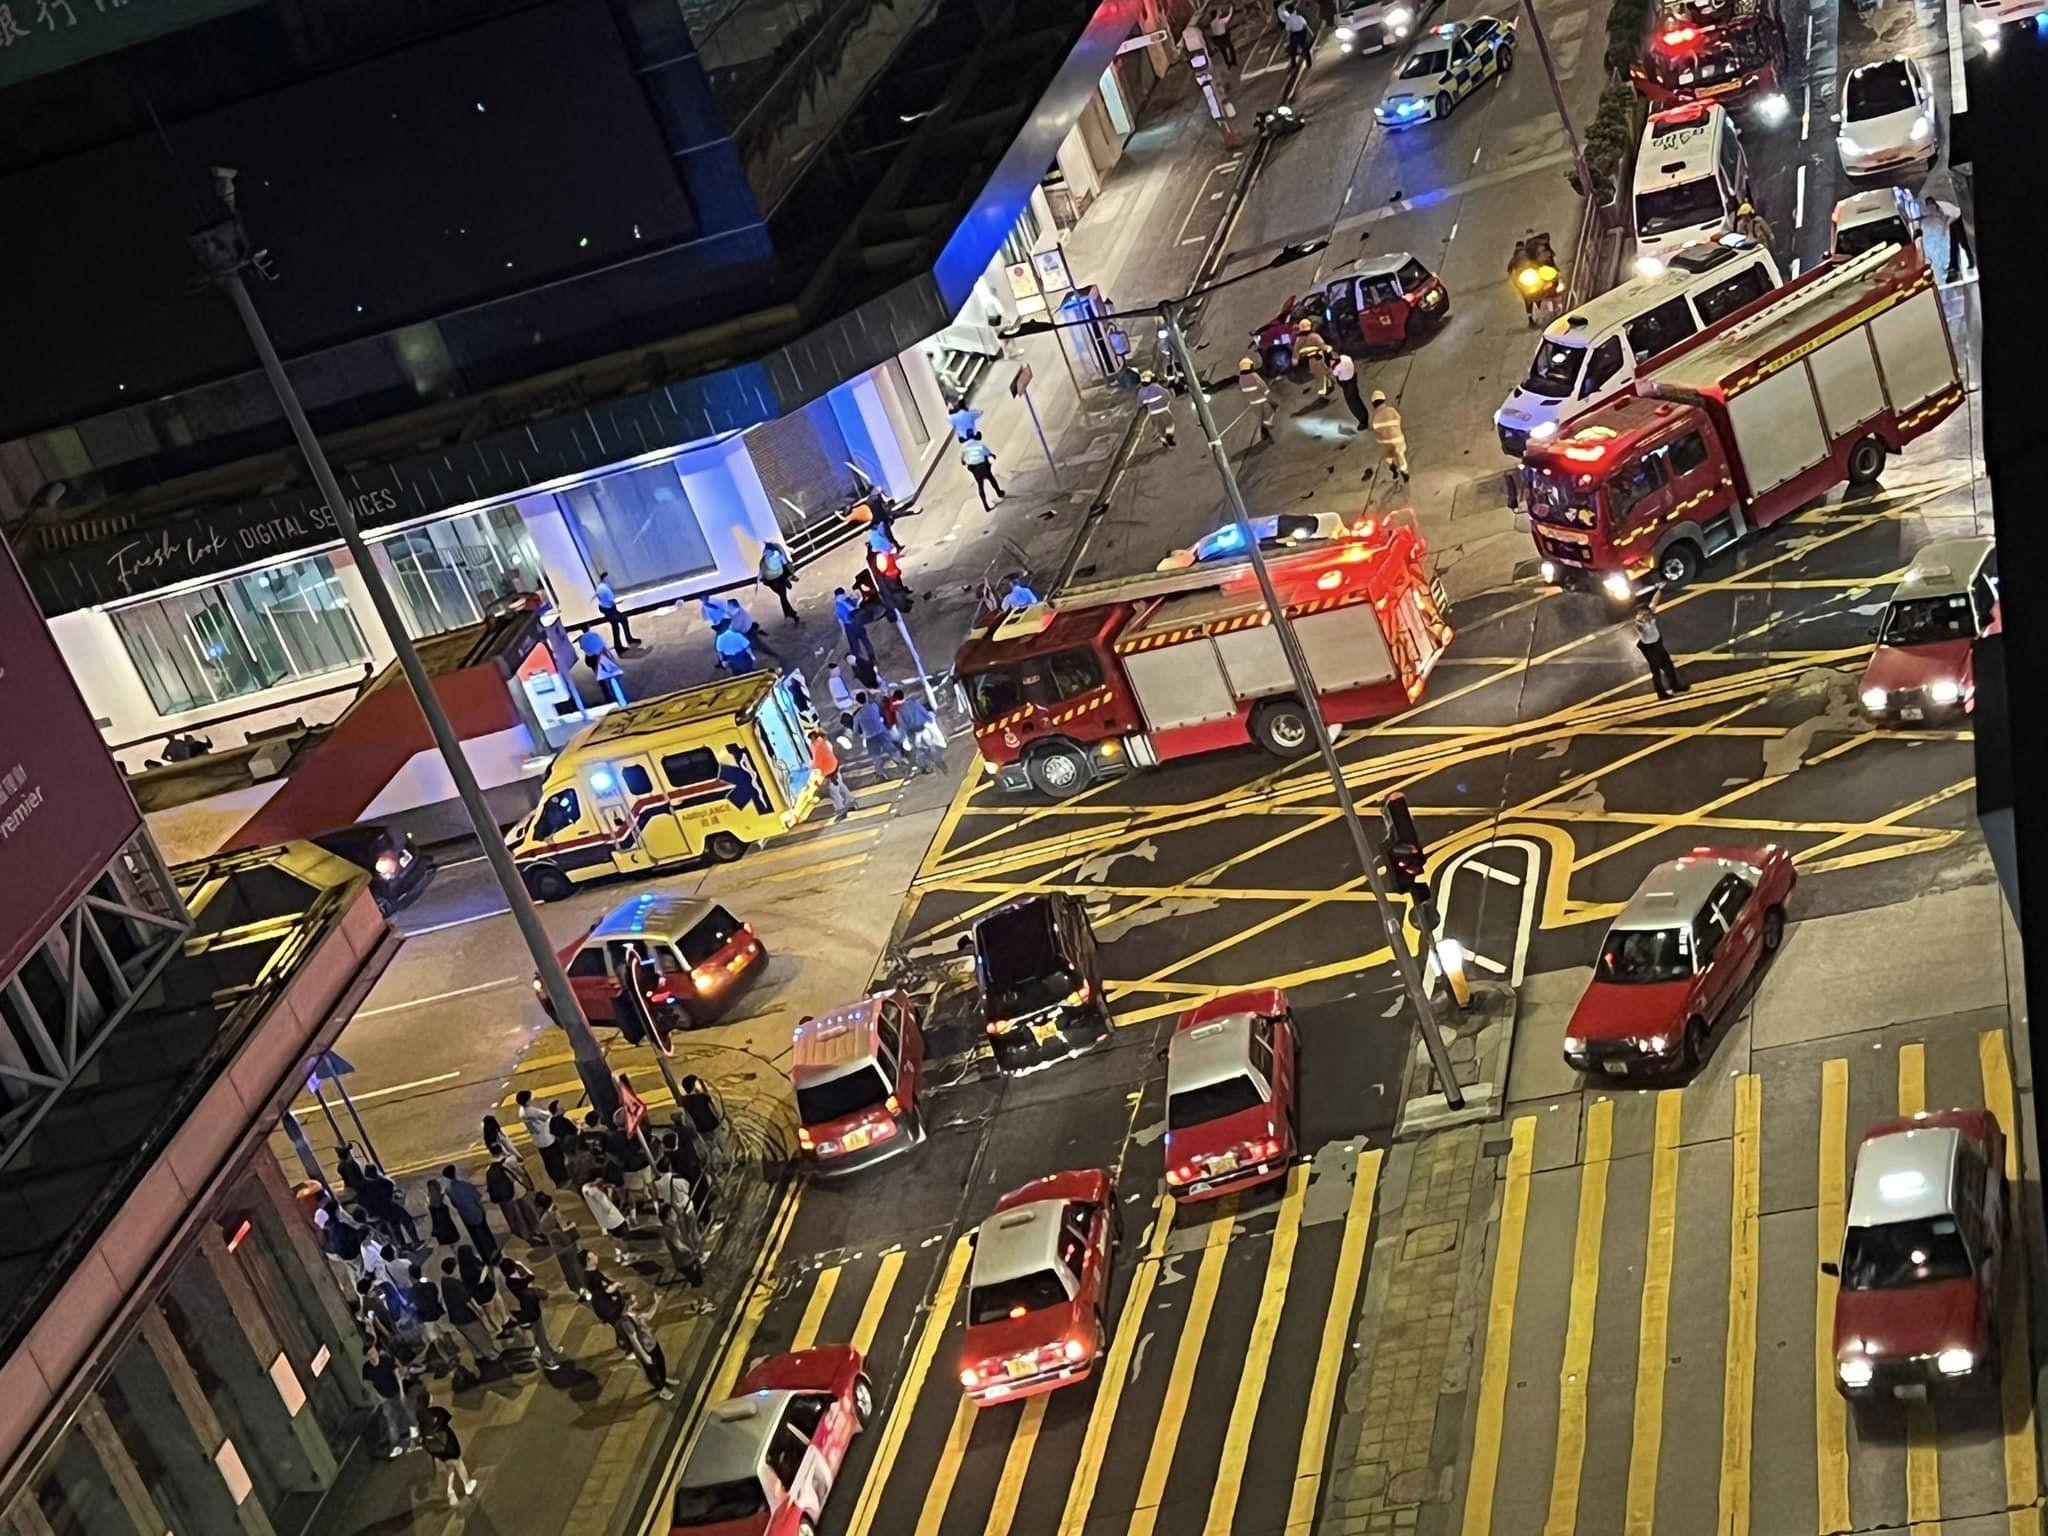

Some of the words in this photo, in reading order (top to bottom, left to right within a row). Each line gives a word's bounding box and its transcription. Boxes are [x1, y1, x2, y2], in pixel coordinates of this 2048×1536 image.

[107, 528, 181, 594] Fresh
[239, 515, 309, 550] DIGITAL
[312, 489, 398, 529] SEVICES
[0, 785, 44, 839] remier
